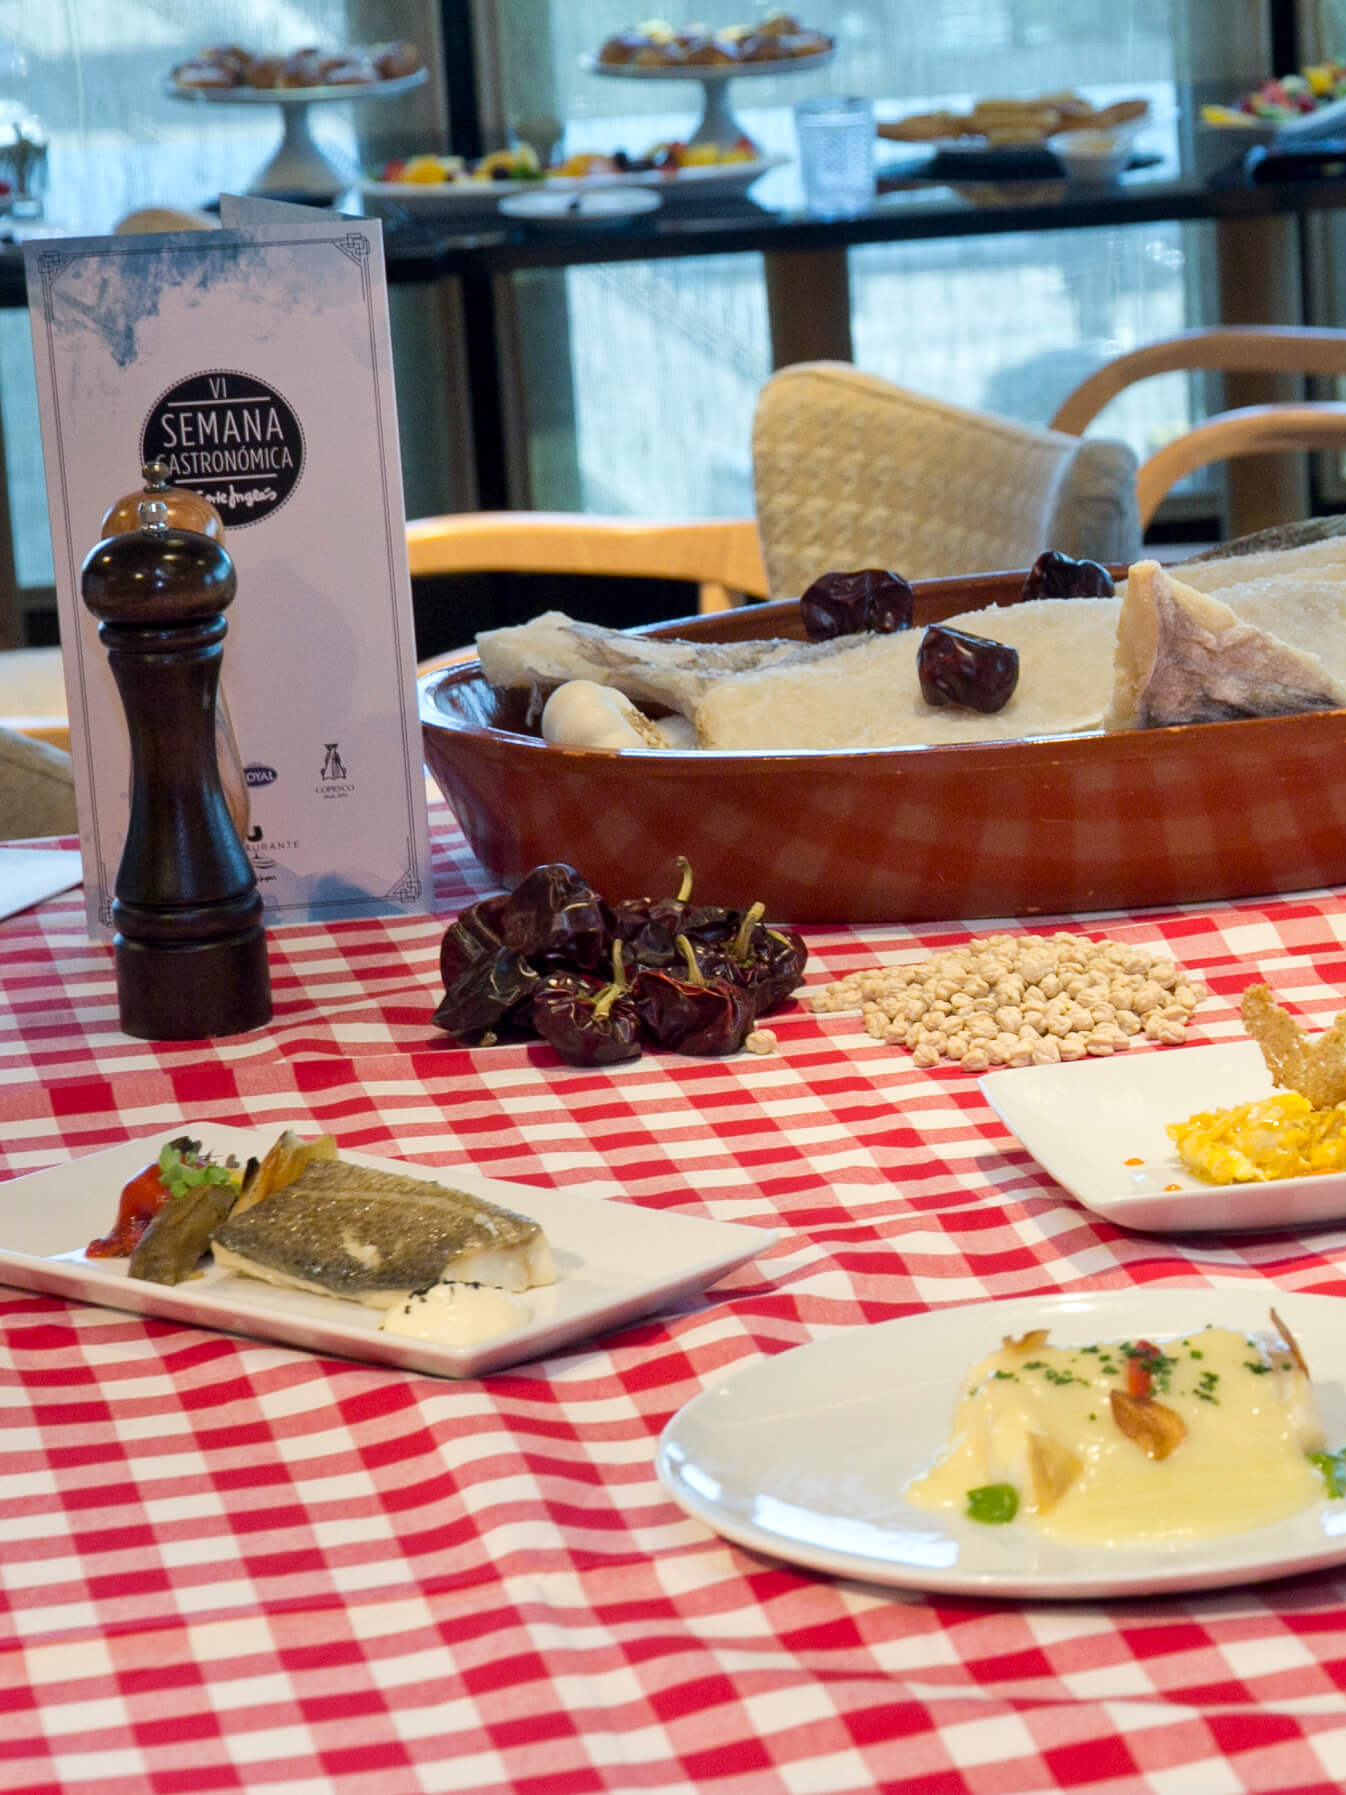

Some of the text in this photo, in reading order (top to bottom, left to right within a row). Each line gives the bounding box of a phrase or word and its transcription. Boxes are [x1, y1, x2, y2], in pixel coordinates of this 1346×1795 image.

[208, 377, 228, 399] VI
[161, 407, 285, 448] SEMANA
[246, 770, 274, 783] OYAL
[246, 840, 300, 851] AURANTE
